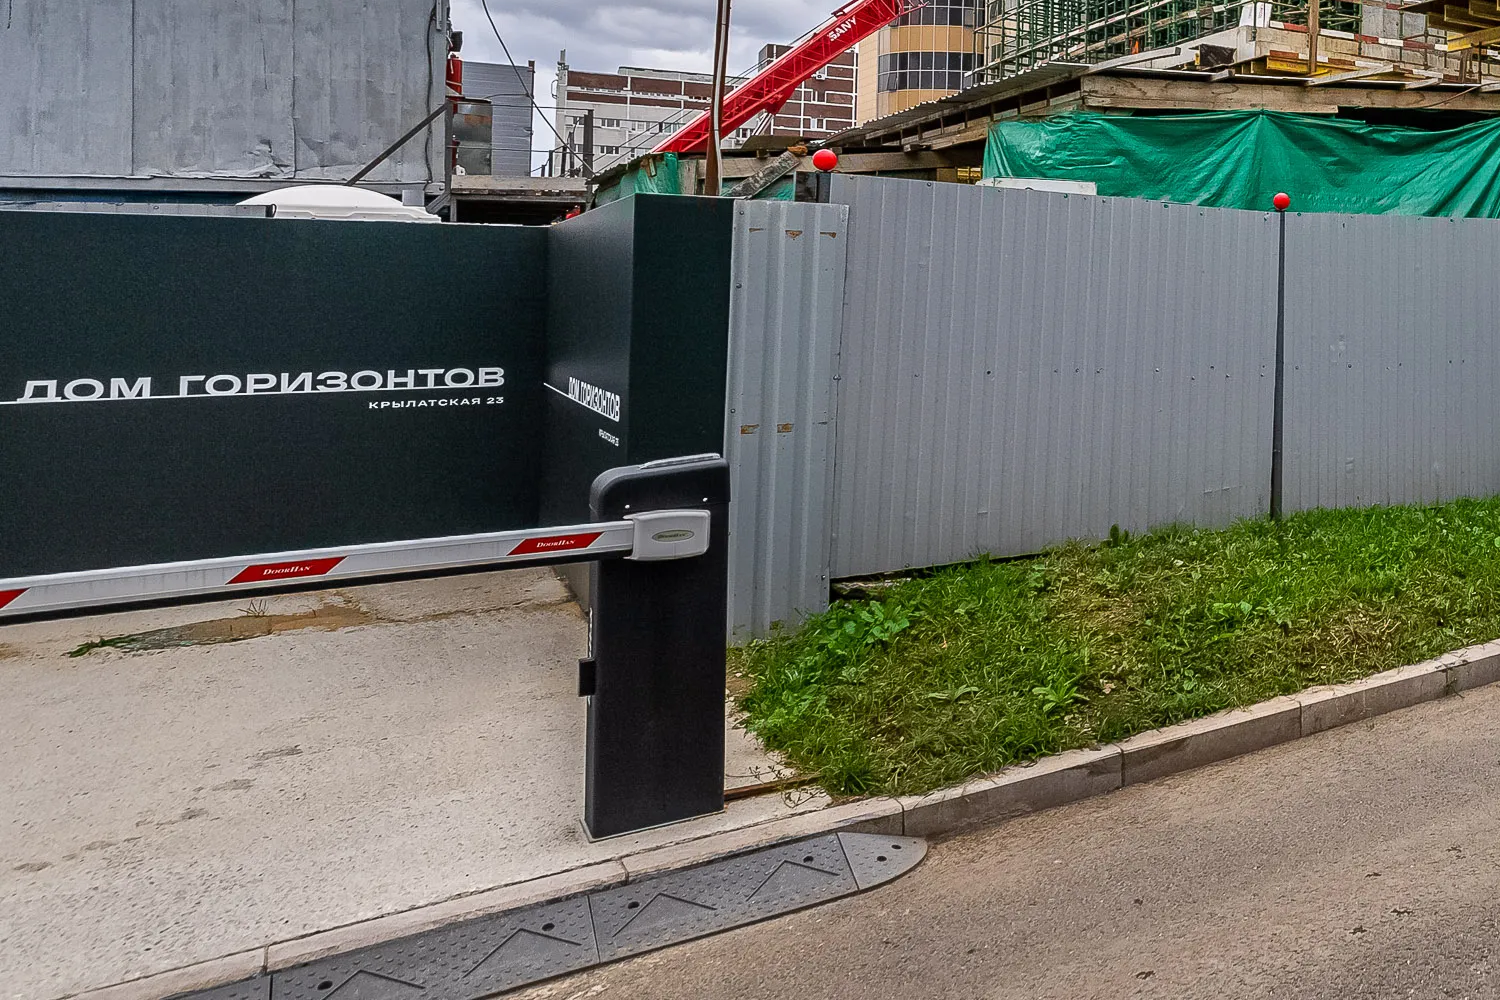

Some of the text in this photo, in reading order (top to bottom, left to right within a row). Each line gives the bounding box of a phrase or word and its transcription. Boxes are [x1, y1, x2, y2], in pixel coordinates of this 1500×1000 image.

[827, 15, 857, 42] SANY
[17, 368, 505, 402] ДОМ ГОРИЗОНТОВ
[368, 396, 504, 409] КРЫЛАТСКАЯ 23
